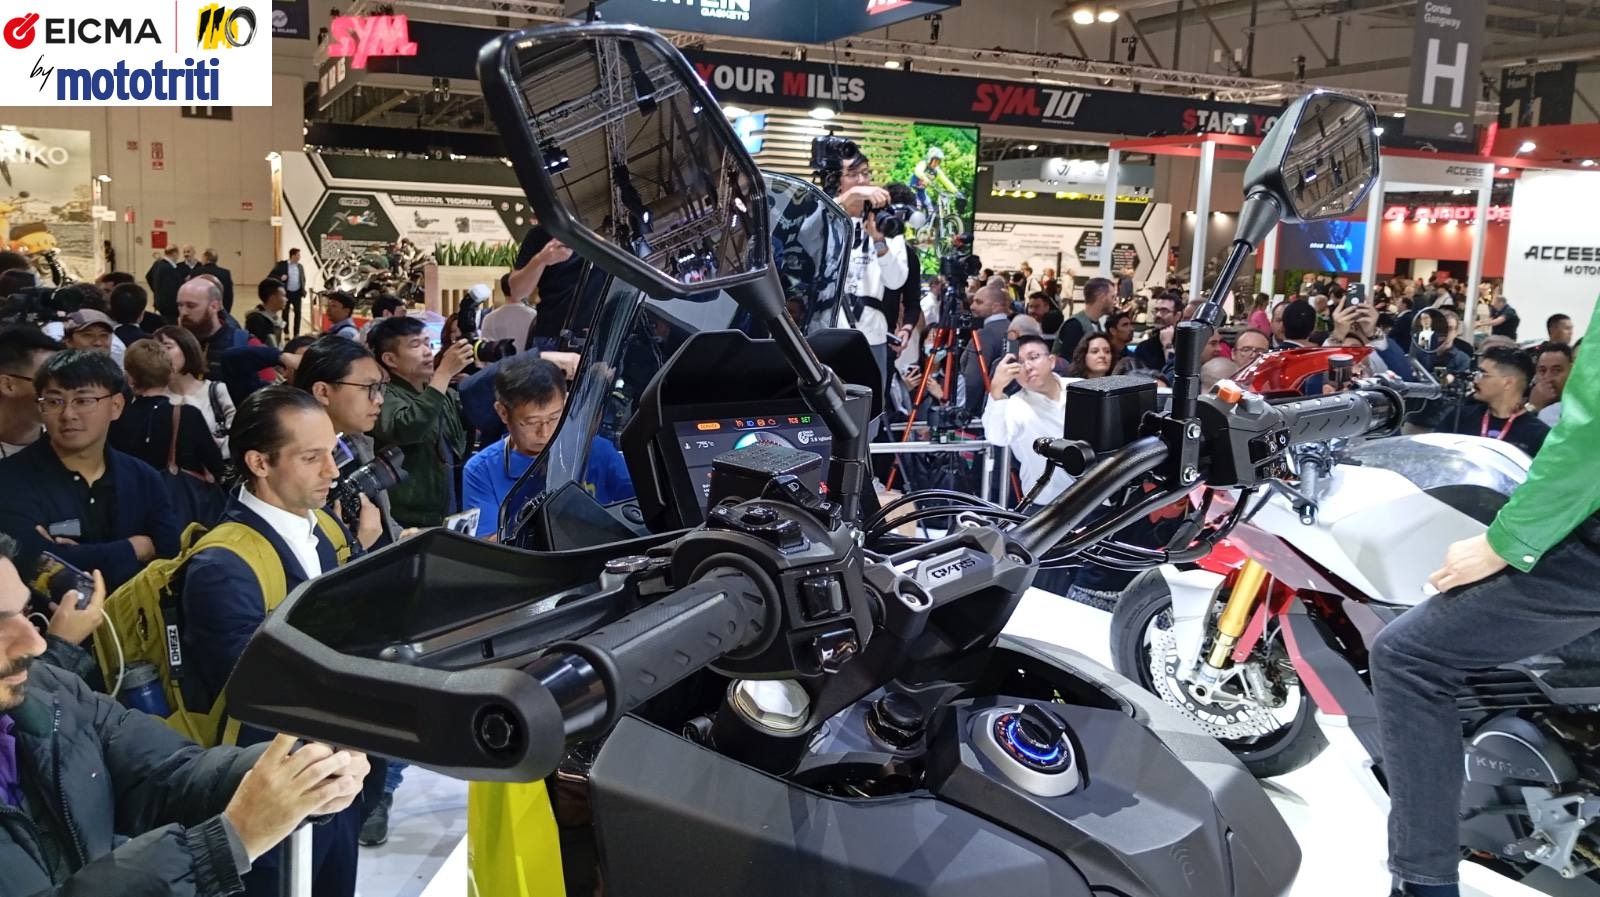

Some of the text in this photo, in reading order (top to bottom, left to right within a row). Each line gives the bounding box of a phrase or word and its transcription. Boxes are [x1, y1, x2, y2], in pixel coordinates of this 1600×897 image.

[701, 7, 750, 21] GASKETS
[1424, 13, 1462, 30] Gangway
[1425, 2, 1452, 15] Corsia
[328, 15, 418, 69] SYM
[695, 63, 866, 102] YOUR MILES
[1422, 38, 1469, 108] H
[971, 83, 1084, 121] SYM 70
[1503, 96, 1543, 129] 11
[1182, 108, 1248, 134] START
